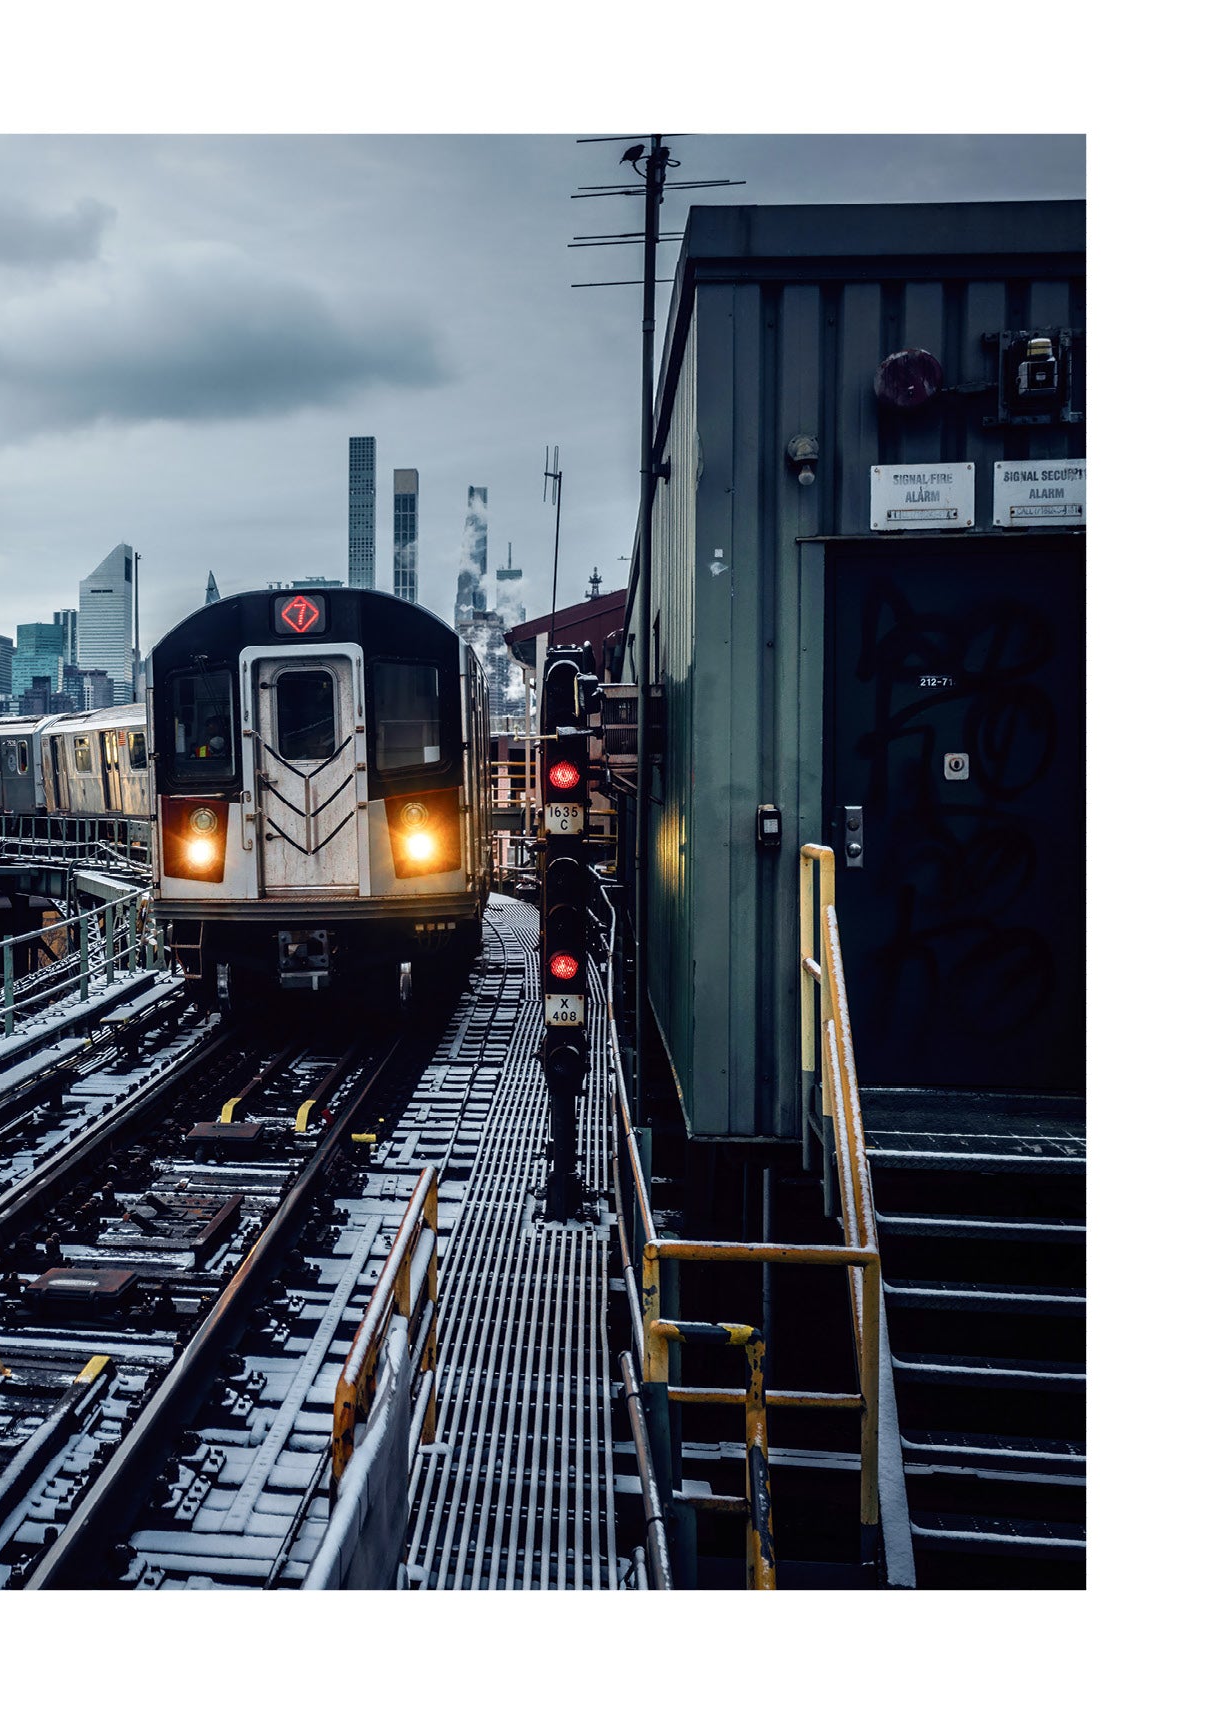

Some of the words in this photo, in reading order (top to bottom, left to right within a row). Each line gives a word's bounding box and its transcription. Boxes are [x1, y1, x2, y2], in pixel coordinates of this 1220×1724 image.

[893, 473, 928, 485] SIGNAL
[930, 473, 953, 484] FIRE
[1003, 471, 1039, 482] SIGNAL
[905, 490, 940, 503] ALARM
[1029, 488, 1065, 499] ALARM
[293, 603, 306, 626] 7
[550, 806, 578, 818] 1635
[561, 819, 568, 831] C
[560, 998, 569, 1009] X
[552, 1011, 577, 1022] 408
